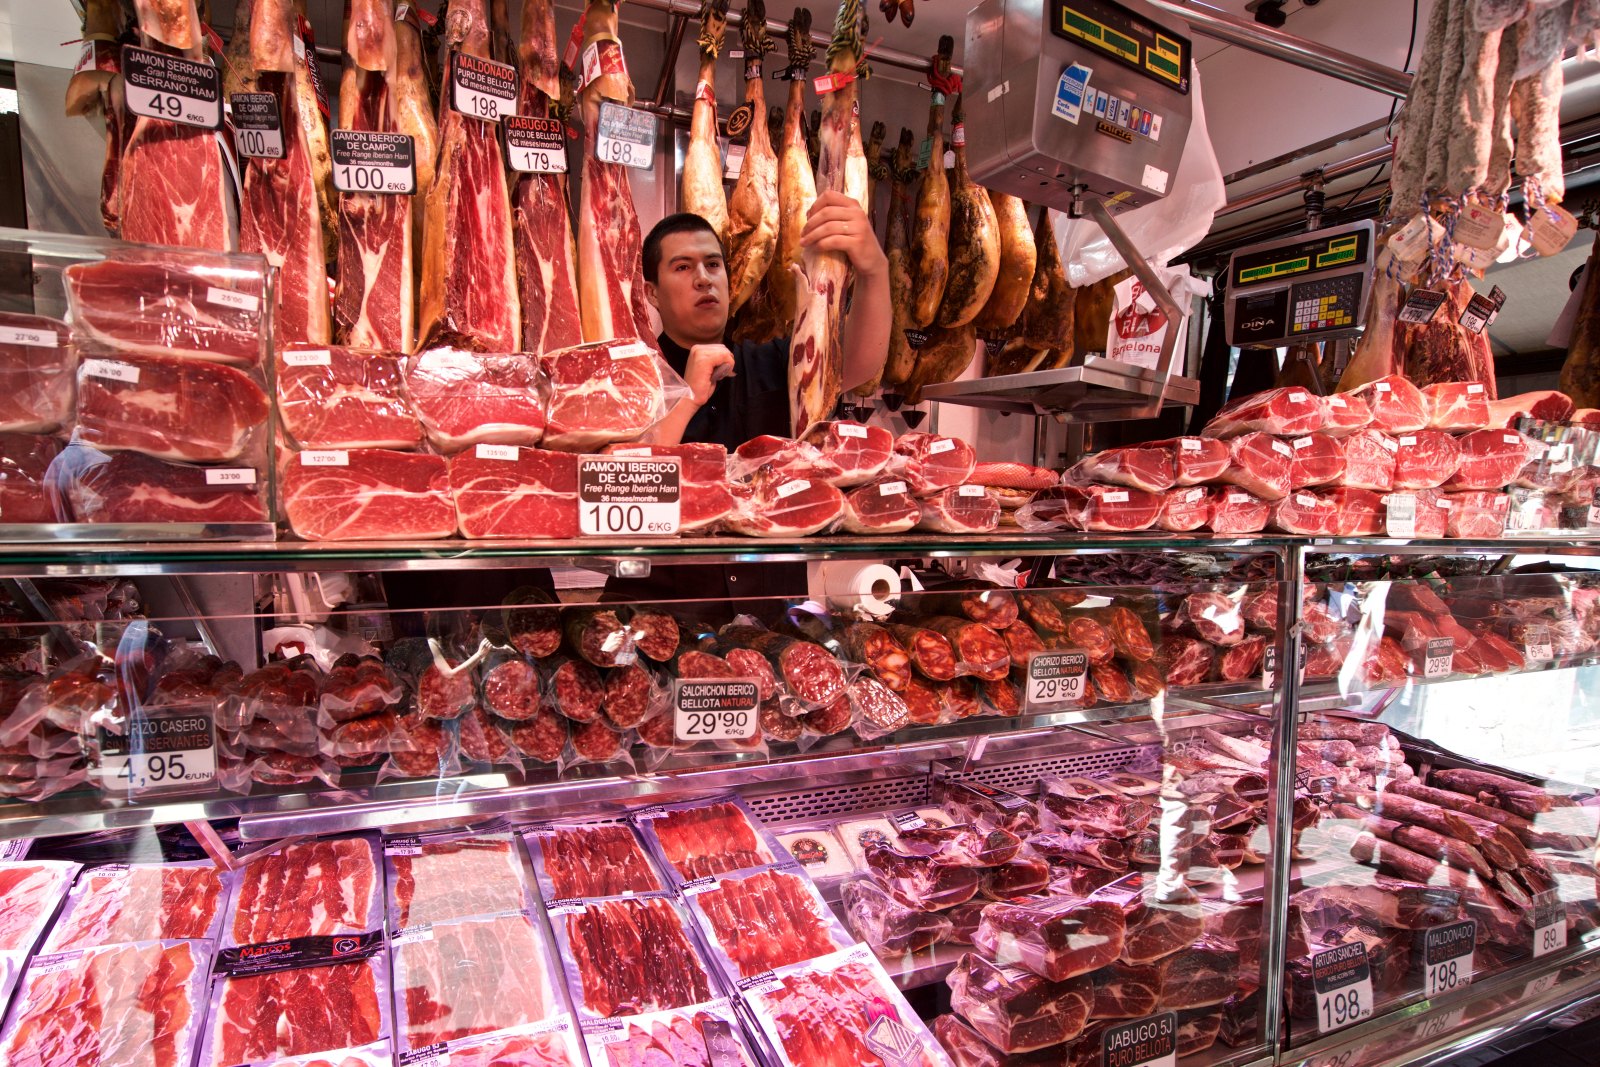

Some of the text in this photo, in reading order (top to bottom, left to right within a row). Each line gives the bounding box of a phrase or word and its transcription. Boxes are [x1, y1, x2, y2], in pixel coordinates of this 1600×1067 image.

[130, 52, 214, 80] JAMON SERRANO
[459, 55, 515, 81] MALDONADO
[132, 73, 215, 99] SERRANO HAM
[458, 68, 516, 91] PURO DE BELLOTA
[460, 78, 514, 99] 48 meses/months
[232, 94, 274, 104] JAMON IBERICO
[471, 95, 498, 119] 198
[1057, 100, 1070, 110] Cards
[148, 94, 205, 124] 49 €/KG
[238, 104, 268, 113] DE CAMPO
[1056, 106, 1076, 119] Welcome
[510, 118, 560, 132] JABUGO 5J
[240, 131, 264, 154] 100
[334, 133, 406, 144] JAMON IBERICO
[508, 130, 525, 138] PURO
[536, 132, 562, 141] BELLOTA
[511, 138, 562, 150] 48 meses/months
[347, 142, 396, 152] DE CAMPO
[352, 150, 372, 160] Range
[372, 152, 394, 160] Iberian
[394, 152, 409, 160] Ham
[603, 140, 632, 163] 198
[524, 152, 550, 170] 179
[342, 166, 406, 191] 100 €/KG
[1112, 342, 1160, 358] Barcelona
[583, 462, 676, 473] JAMON IBERICO
[598, 474, 662, 484] DE CAMPO
[584, 484, 678, 494] Free Range Iberian Ham
[590, 504, 672, 532] 100 €/KG
[1034, 655, 1084, 666] CHORIZO IBERICO
[1428, 657, 1450, 674] 29'90
[1033, 666, 1084, 677] BELLOTA NATURAL
[682, 684, 754, 696] SALCHICHON IBERICO
[1036, 678, 1078, 698] 29'90
[682, 698, 754, 708] BELLOTA NATURAL
[160, 718, 206, 733] CASERO
[686, 712, 748, 736] 29'90 €/Kg
[118, 754, 213, 787] 4,95 €/UNI
[1429, 924, 1473, 947] MALDONADO
[1543, 928, 1556, 950] 89
[1315, 942, 1363, 968] ARTURO SANCHEZ
[1430, 960, 1457, 994] 198
[1322, 988, 1360, 1028] 198
[580, 1016, 622, 1027] MALDONADO
[1108, 1017, 1173, 1051] JABUGO 5J
[405, 1044, 432, 1058] JABUGO
[1109, 1037, 1171, 1067] PURO BELLOTA
